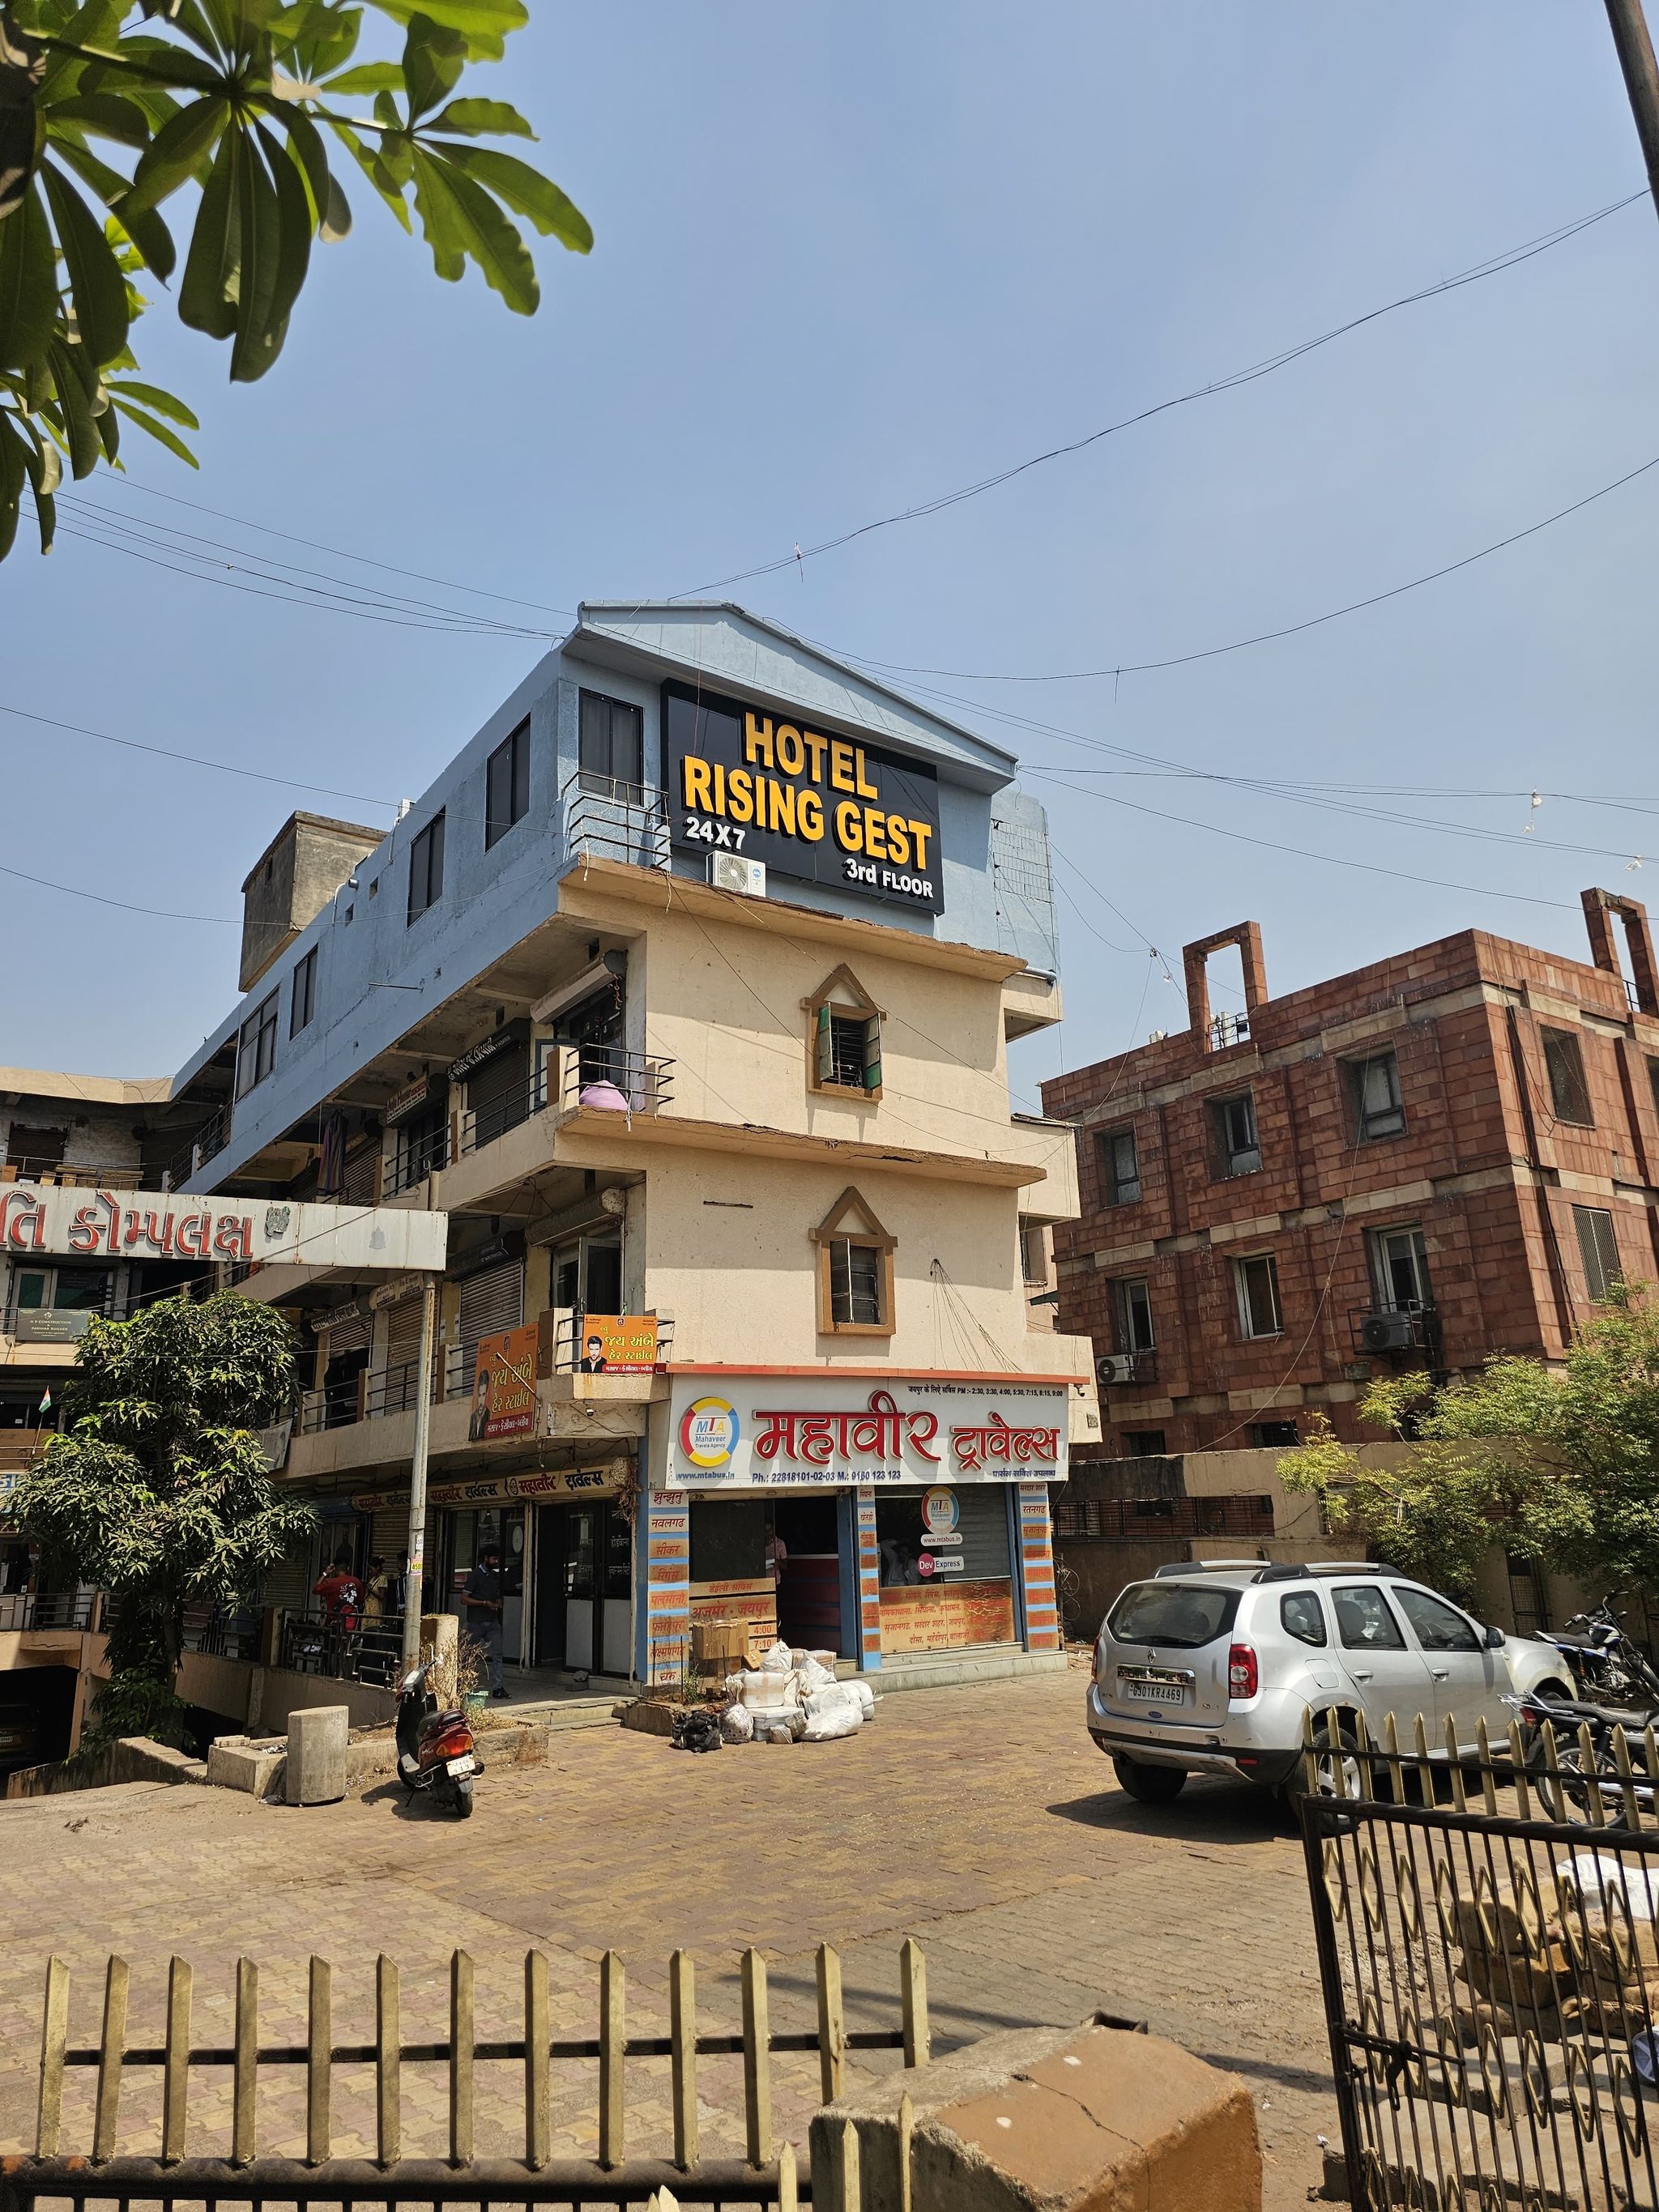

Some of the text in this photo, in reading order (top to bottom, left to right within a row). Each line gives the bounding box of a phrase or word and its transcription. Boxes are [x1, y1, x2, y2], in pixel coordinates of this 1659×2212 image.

[744, 711, 879, 801] HOTEL
[683, 754, 932, 871] RISING GEST
[684, 816, 746, 850] 24X7
[846, 858, 934, 899] 3rd FLOOR
[604, 1332, 655, 1348] જય અંબે
[608, 1348, 621, 1360] હેર
[492, 1369, 509, 1388] જય
[907, 1386, 923, 1396] जयपुर
[923, 1383, 930, 1393] के
[972, 1387, 985, 1396] 2:30,
[492, 1392, 503, 1413] હેર
[696, 1417, 727, 1433] MTA
[753, 1389, 1062, 1472] महावीर ट्रावेल्स
[676, 1471, 736, 1481] www.mtabus.in
[752, 1473, 769, 1484] Ph.:
[771, 1472, 835, 1483] 22818101-02-03
[872, 1471, 886, 1481] 123
[888, 1470, 902, 1481] 123
[930, 1499, 950, 1511] MTA
[923, 1535, 962, 1544] www.mtabus.in
[655, 1542, 680, 1556] सीकर
[919, 1560, 961, 1571] Dev Express
[690, 1600, 772, 1619] अजमेर जयपुर
[753, 1625, 772, 1634] 4:00
[753, 1639, 772, 1649] 7:10
[1117, 1669, 1188, 1684] DUSTER
[1132, 1684, 1182, 1701] GJ01KR4469
